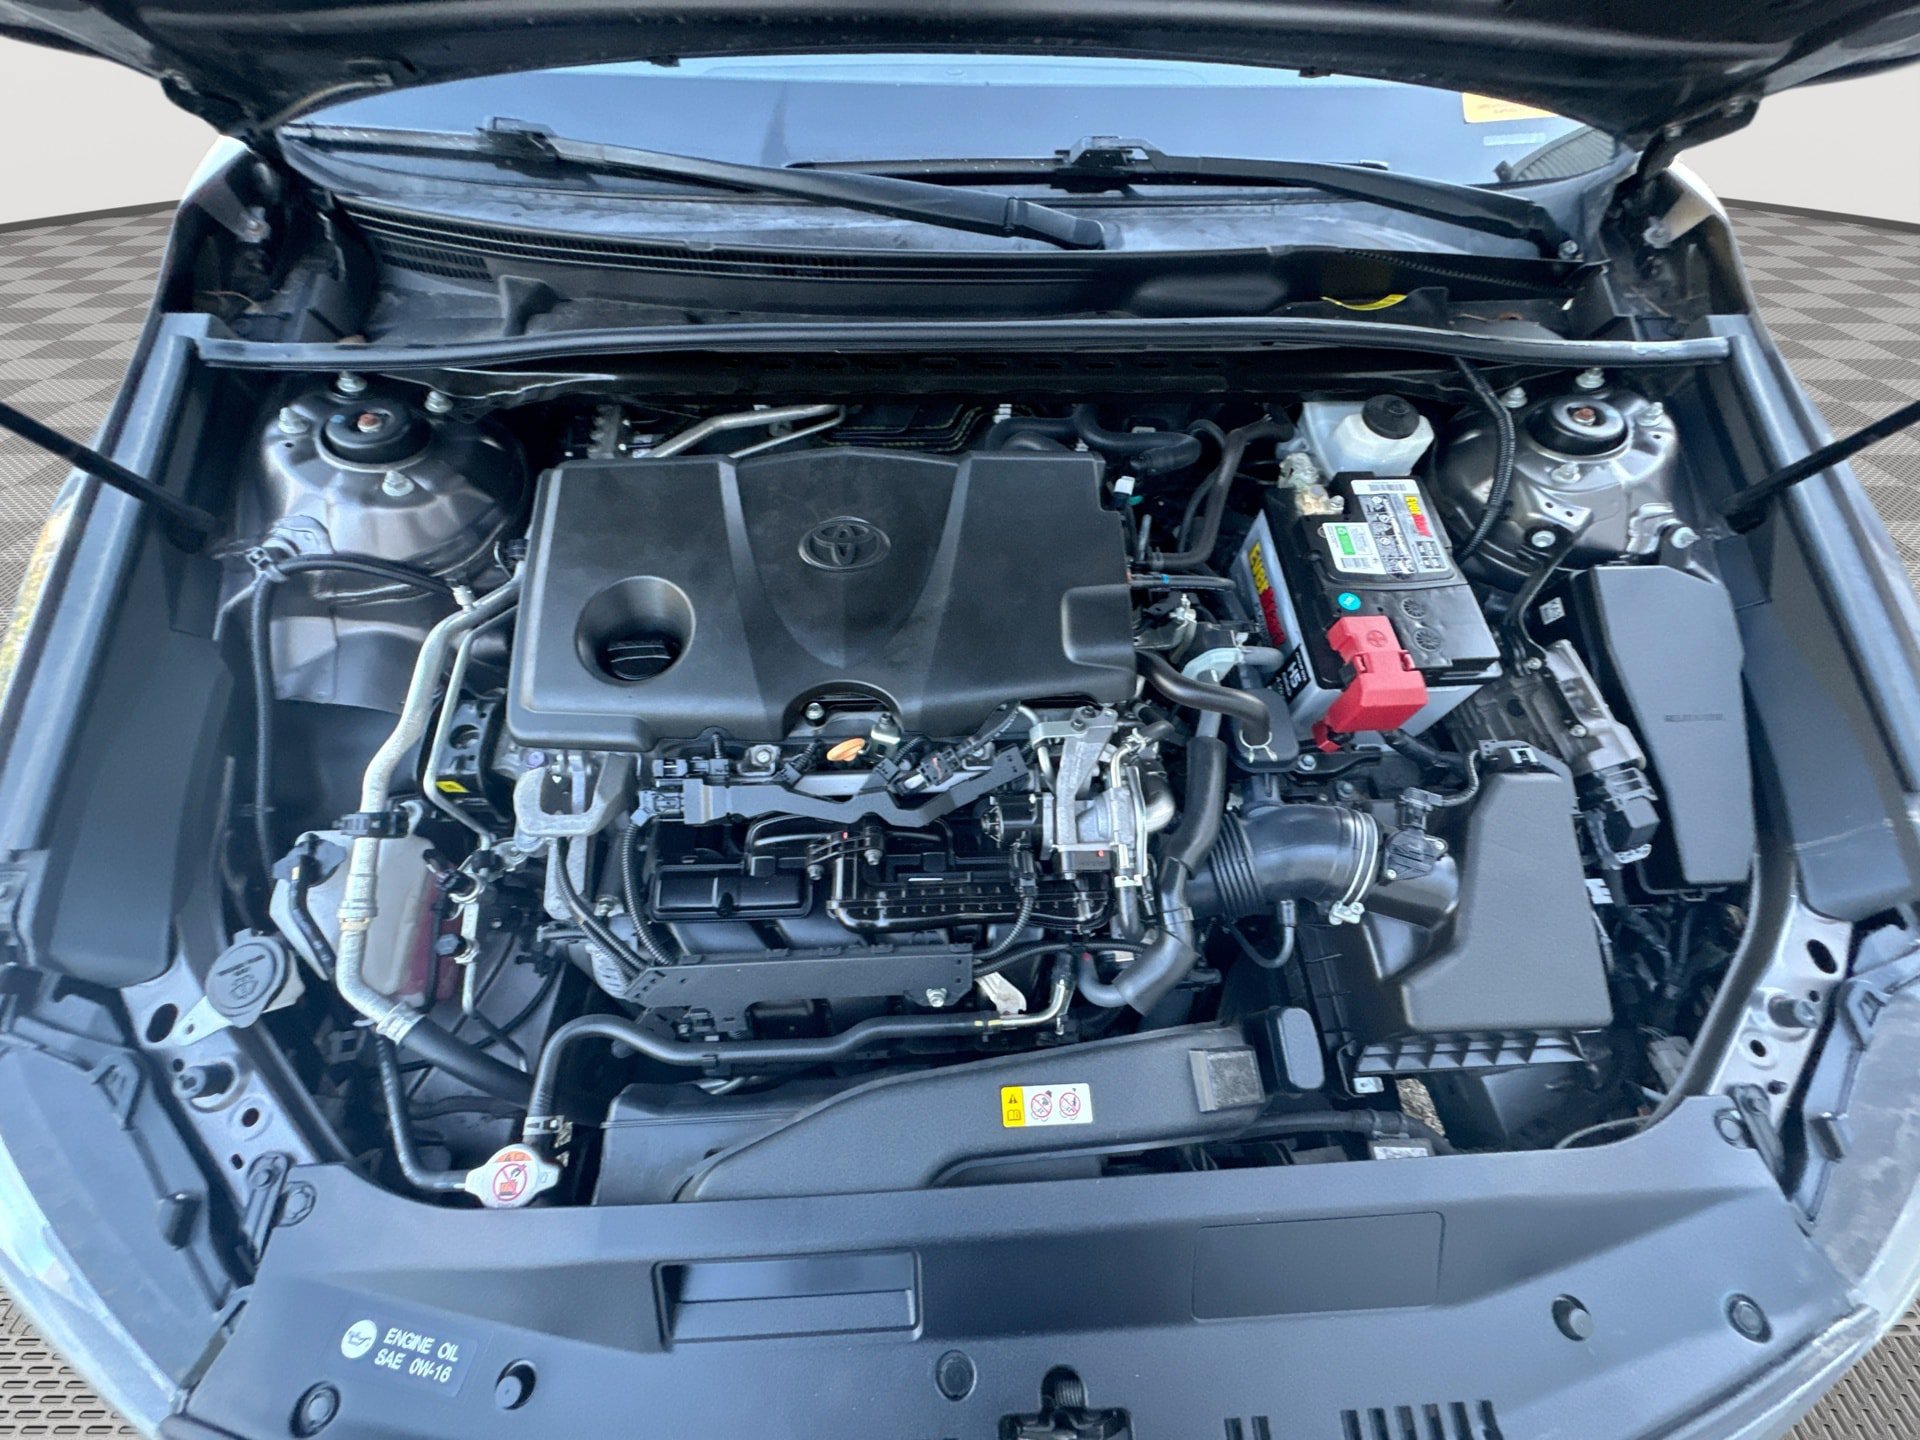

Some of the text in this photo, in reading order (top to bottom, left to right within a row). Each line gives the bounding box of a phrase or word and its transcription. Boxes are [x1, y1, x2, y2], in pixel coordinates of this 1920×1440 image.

[1287, 661, 1302, 688] H5
[384, 1328, 459, 1362] ENGINE OIL
[375, 1349, 453, 1383] SAE 0W-16
